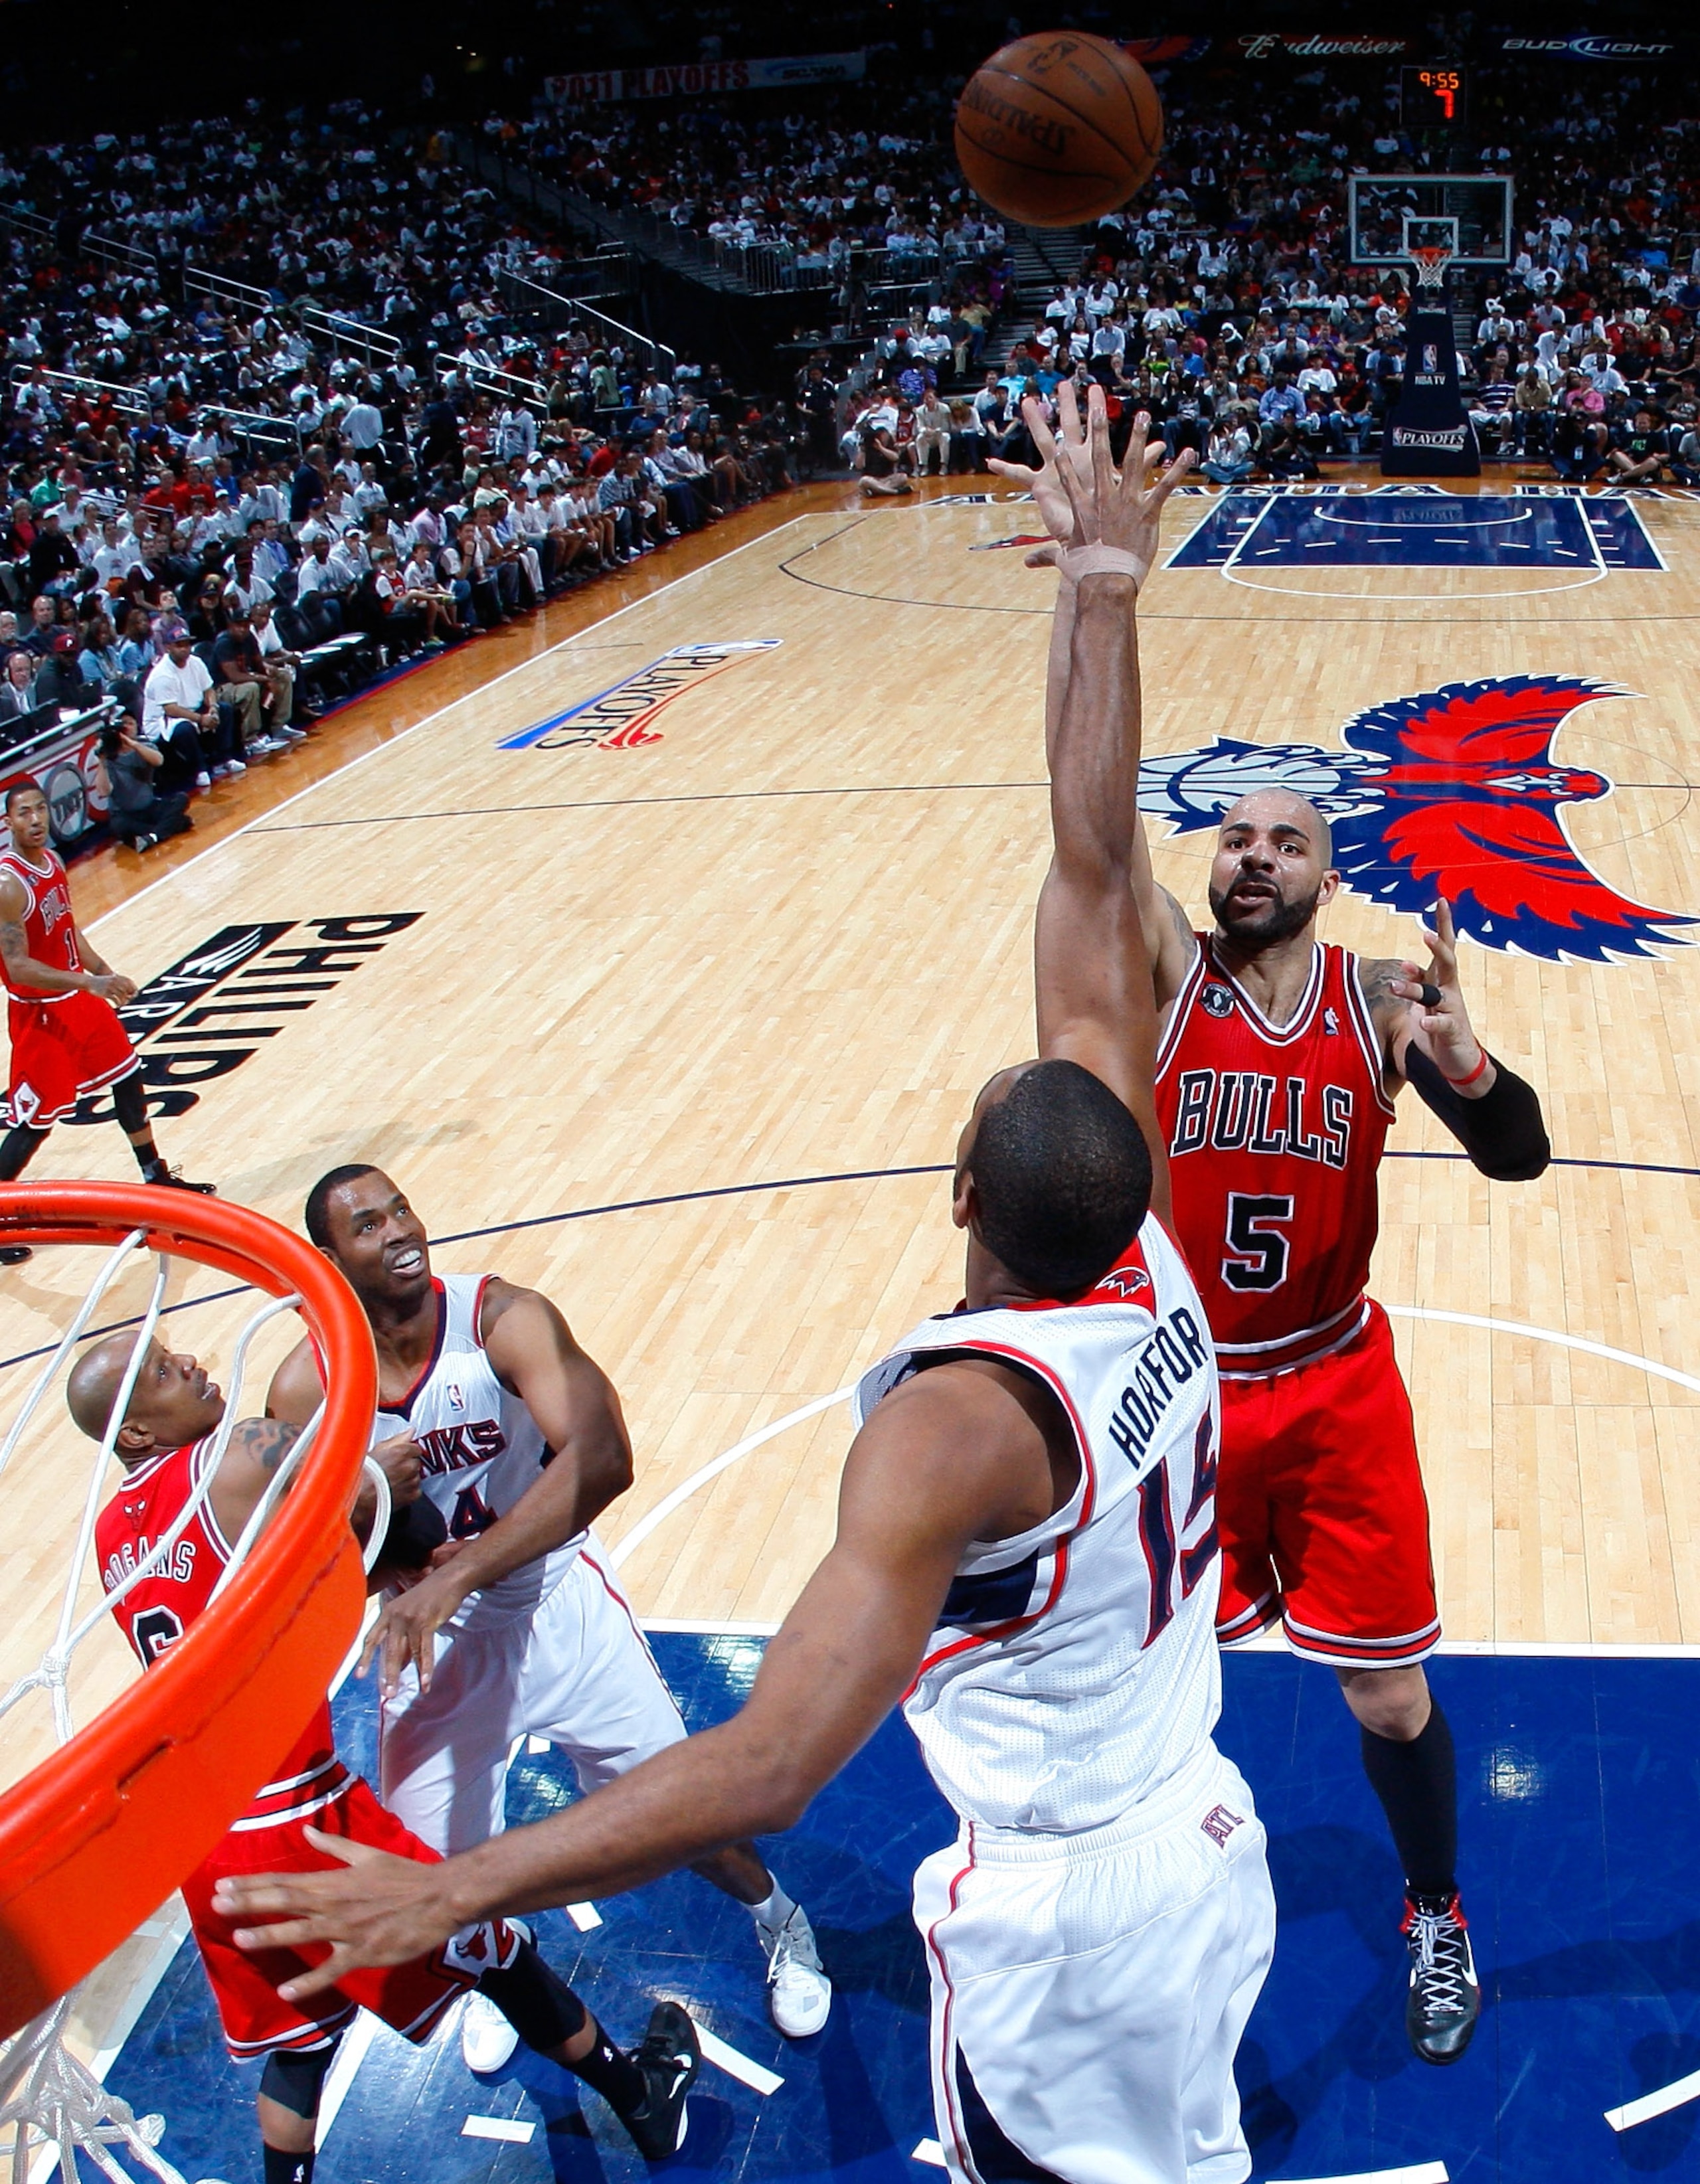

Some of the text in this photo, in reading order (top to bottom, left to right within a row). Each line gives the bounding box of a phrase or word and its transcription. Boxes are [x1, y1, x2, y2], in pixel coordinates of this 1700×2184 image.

[1237, 33, 1406, 58] Budweiser
[1501, 38, 1674, 55] BUD LIGHT
[552, 72, 613, 101] 2011
[622, 62, 750, 98] PLAYOFFS
[1419, 70, 1460, 90] 9:55
[1433, 89, 1456, 120] 7
[1401, 432, 1465, 446] PLAYOFFS
[534, 655, 730, 750] PLAYOFFS
[64, 928, 79, 971] 1
[58, 912, 427, 1125] PHILIPS
[1169, 1068, 1353, 1171] BULLS
[1221, 1191, 1294, 1294] 5
[450, 1483, 499, 1539] 4
[1200, 1804, 1246, 1850] ATL
